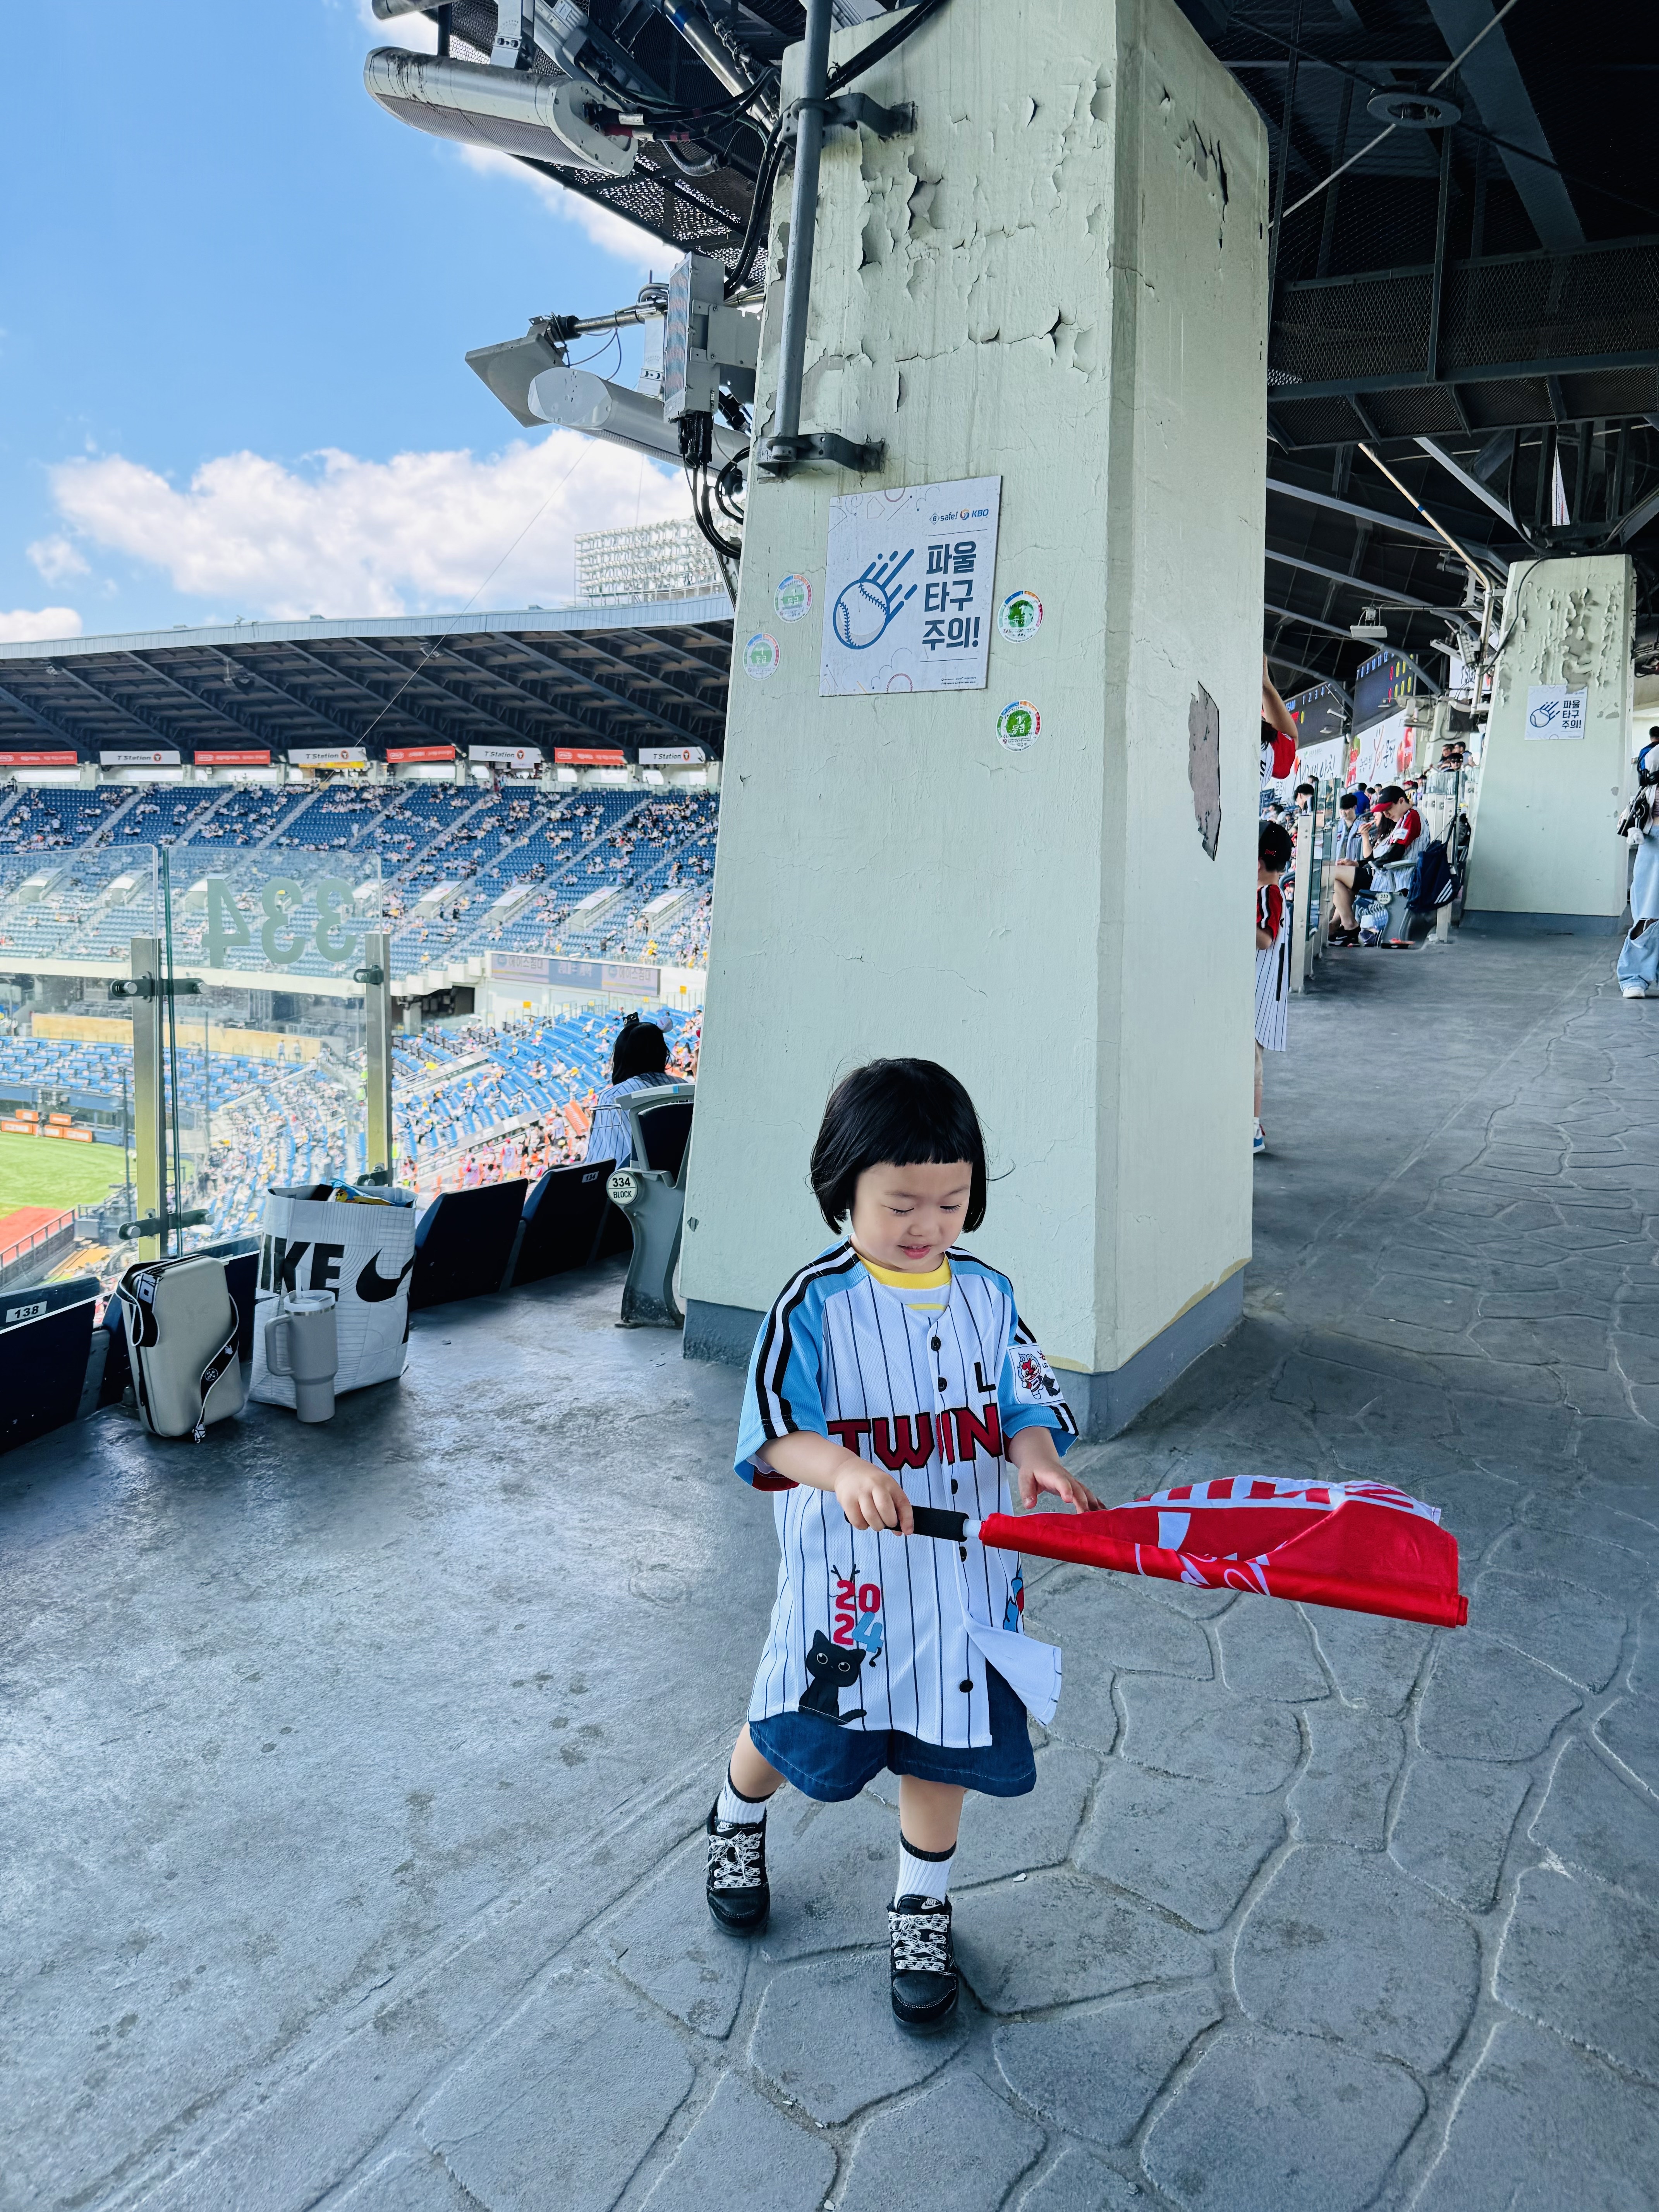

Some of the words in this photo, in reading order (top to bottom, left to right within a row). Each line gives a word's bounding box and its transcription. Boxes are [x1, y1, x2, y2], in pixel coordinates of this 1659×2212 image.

[940, 511, 958, 521] safe!
[972, 509, 989, 518] KBO
[926, 541, 976, 575] 파울
[924, 579, 974, 612] 타구
[922, 617, 980, 651] 주의!
[1563, 700, 1580, 709] 파울
[1563, 710, 1579, 718] 타구
[1562, 720, 1581, 728] 주의!
[612, 1177, 630, 1187] 334
[14, 1305, 39, 1318] 138
[835, 1580, 881, 1613] 20
[833, 1611, 884, 1654] 24
